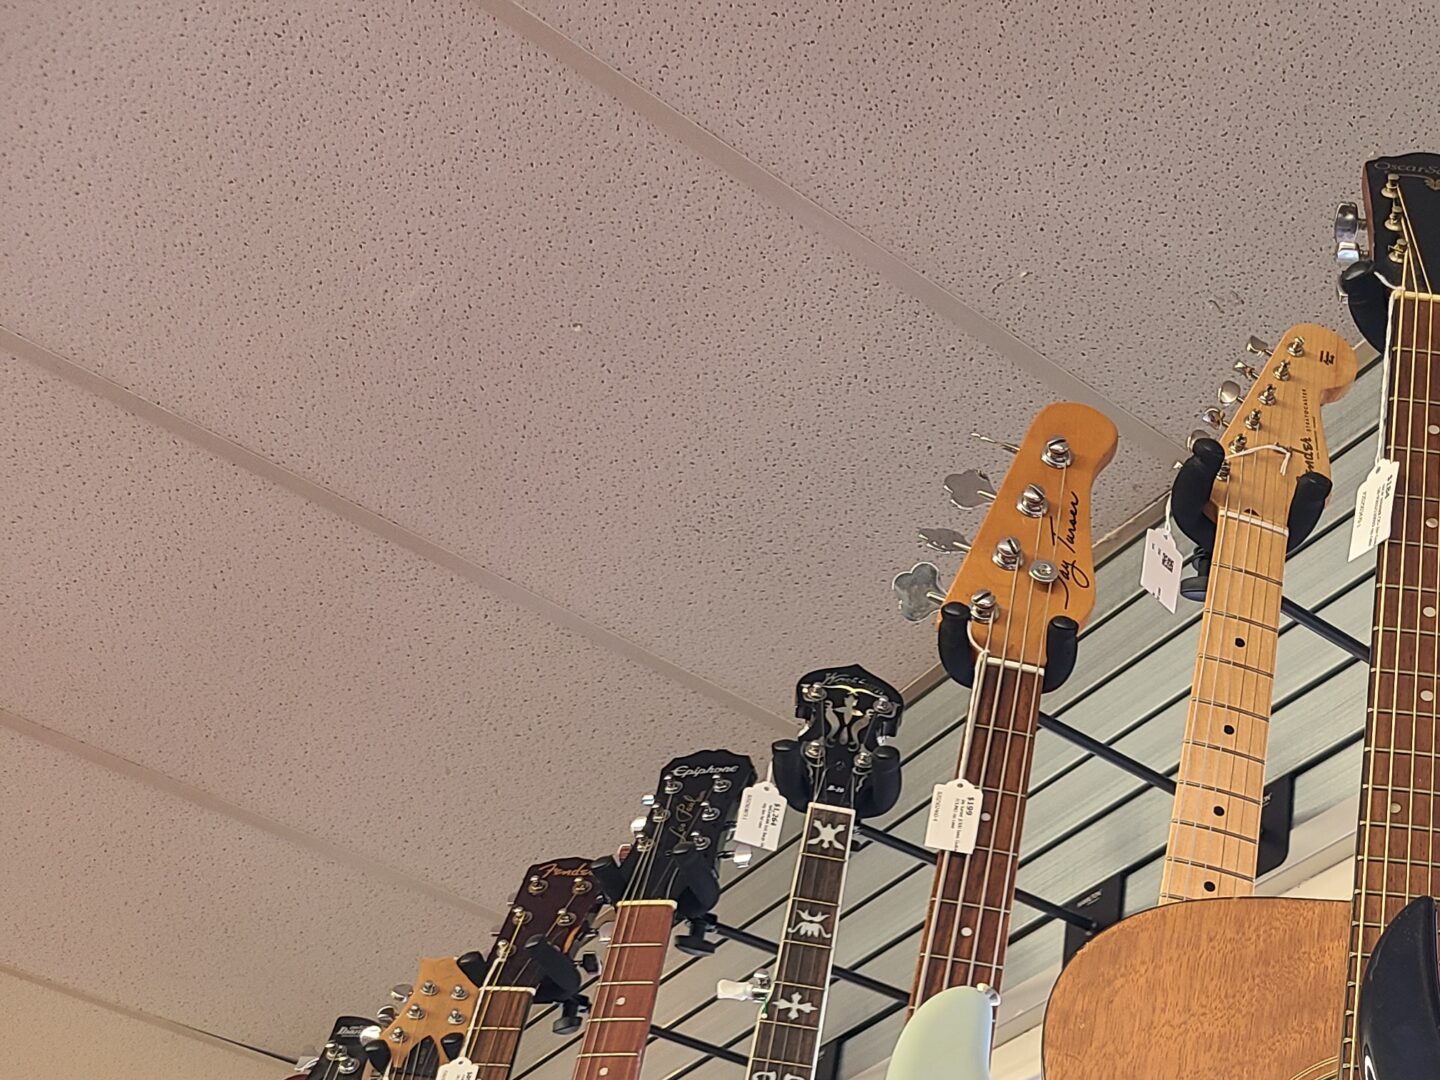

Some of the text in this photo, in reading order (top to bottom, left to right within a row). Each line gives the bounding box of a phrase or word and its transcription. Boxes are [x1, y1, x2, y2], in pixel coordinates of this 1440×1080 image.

[1050, 490, 1090, 610] Jay Turser
[671, 765, 739, 779] Epiphone
[965, 796, 976, 816] $199
